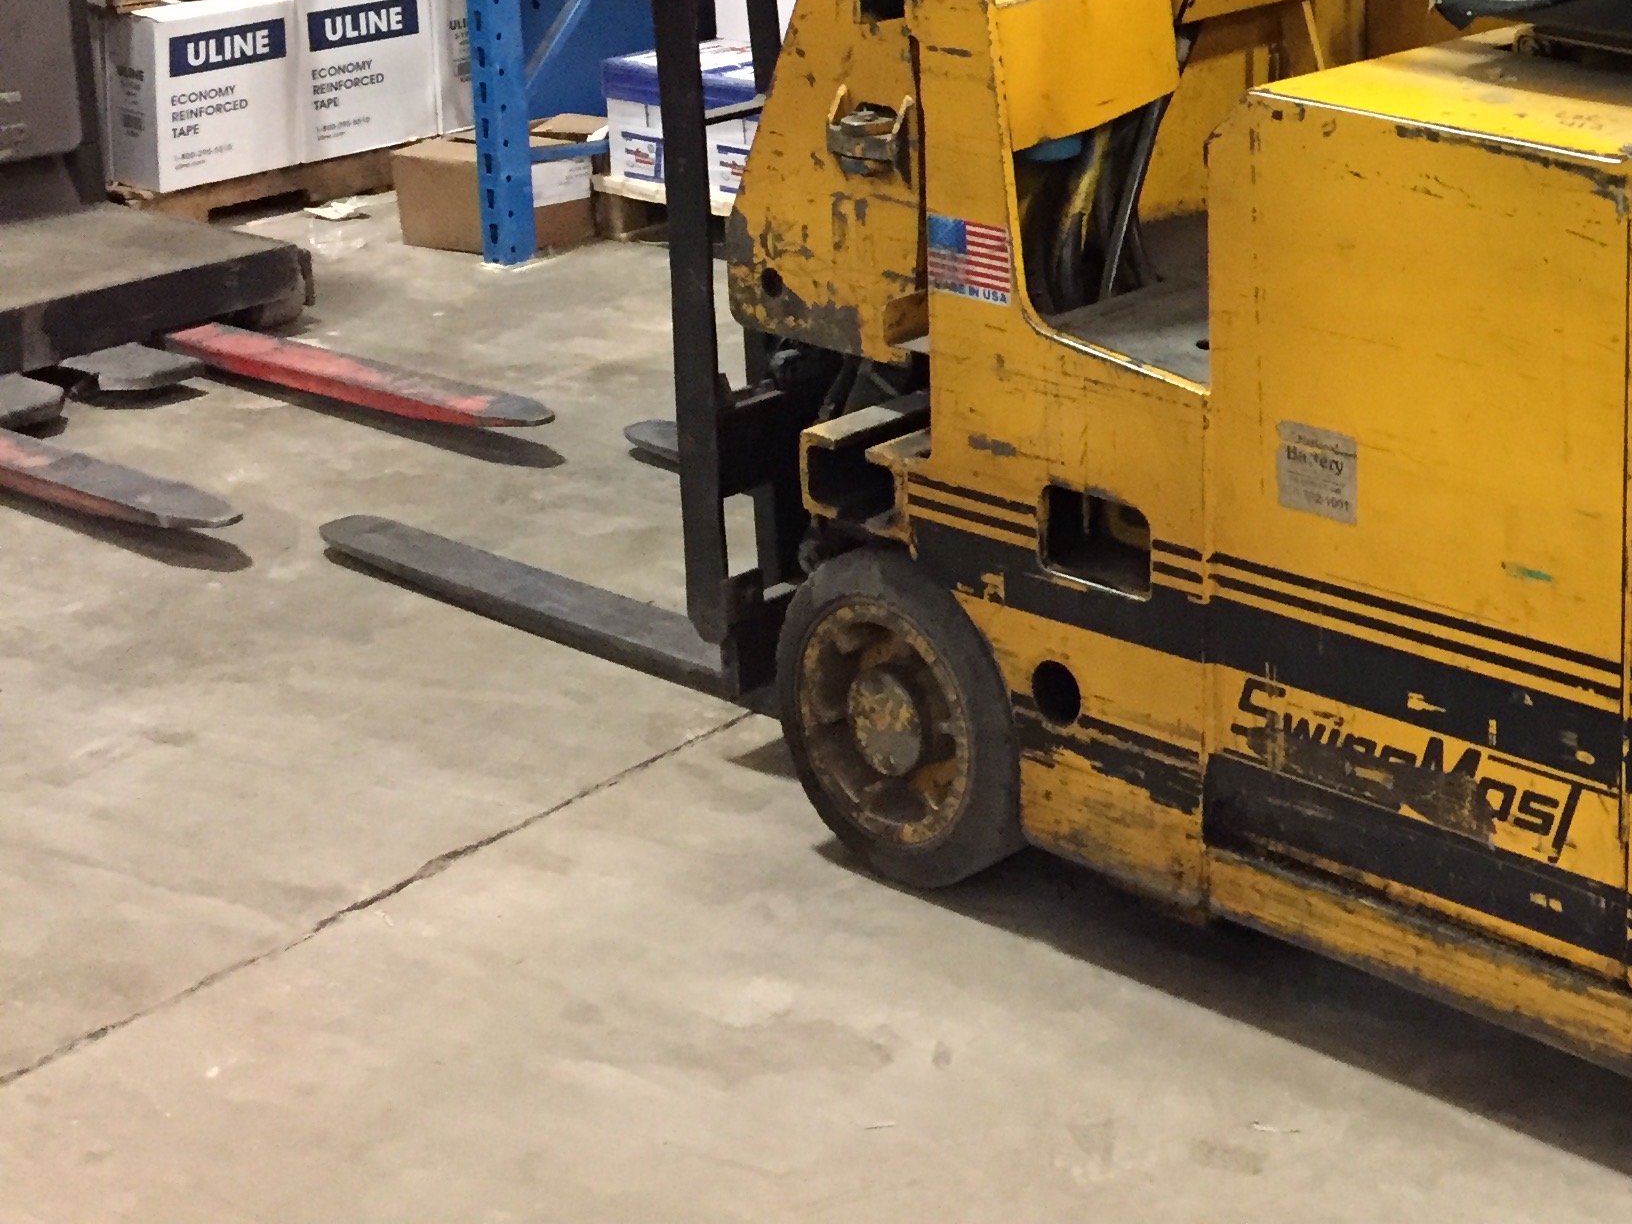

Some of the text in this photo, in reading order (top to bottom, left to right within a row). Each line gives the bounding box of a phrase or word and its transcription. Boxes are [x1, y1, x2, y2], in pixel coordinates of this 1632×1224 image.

[324, 6, 403, 42] ULINE
[449, 18, 467, 31] ULI
[187, 28, 270, 67] ULINE
[311, 59, 373, 81] ECONOMY
[170, 84, 236, 107] ECONOMY
[312, 73, 385, 96] REINFORCED
[171, 98, 249, 122] REINFORCED
[313, 96, 340, 111] TAPE
[172, 123, 200, 138] TAPE
[983, 289, 1008, 304] USA
